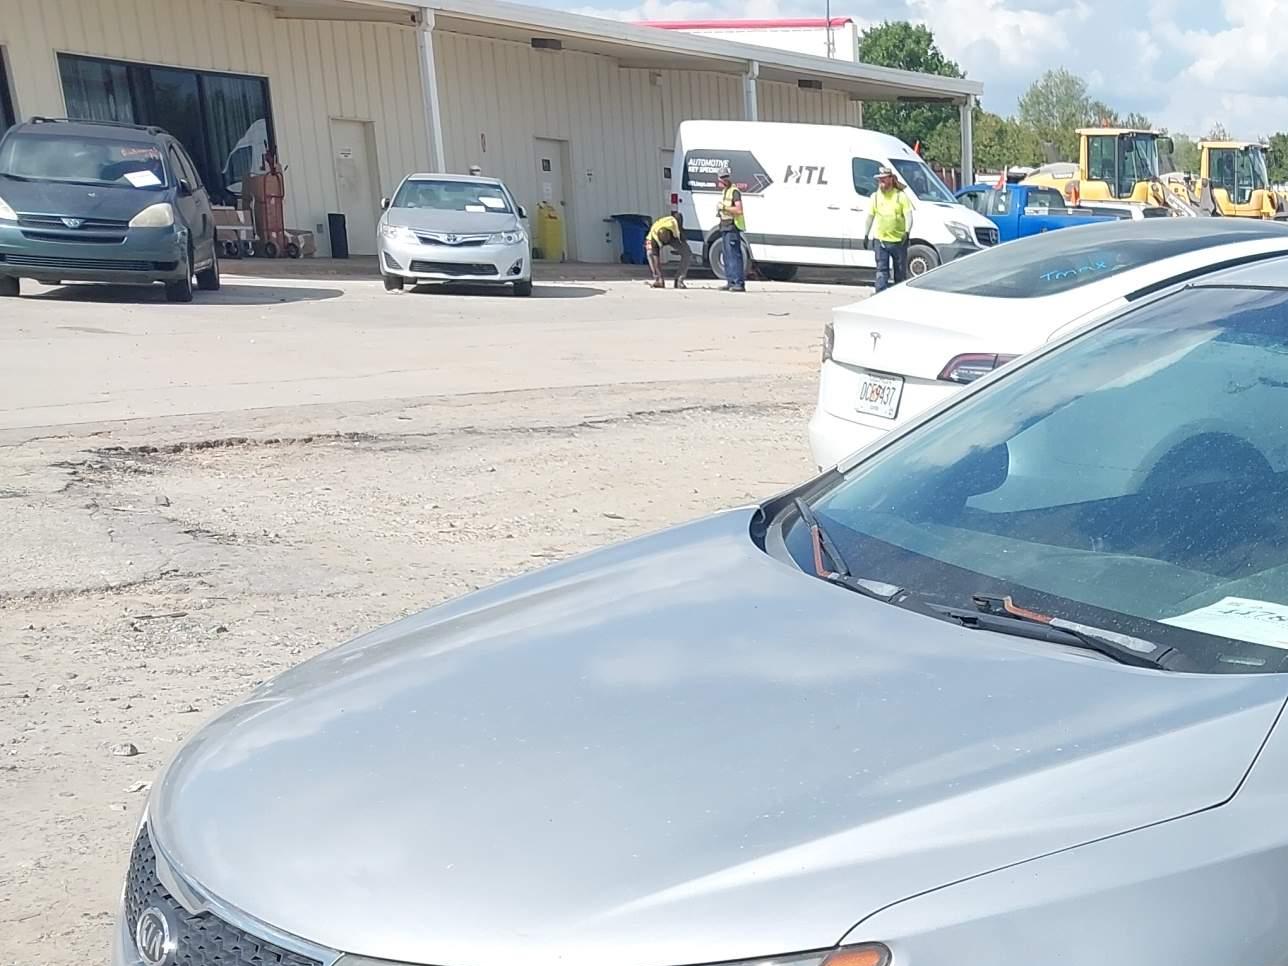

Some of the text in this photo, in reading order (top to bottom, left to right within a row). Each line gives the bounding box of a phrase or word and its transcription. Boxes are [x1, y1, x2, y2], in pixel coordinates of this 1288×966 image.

[688, 158, 730, 168] AUTOMOTIVE
[784, 165, 828, 185] HTL
[141, 915, 164, 961] KIA
